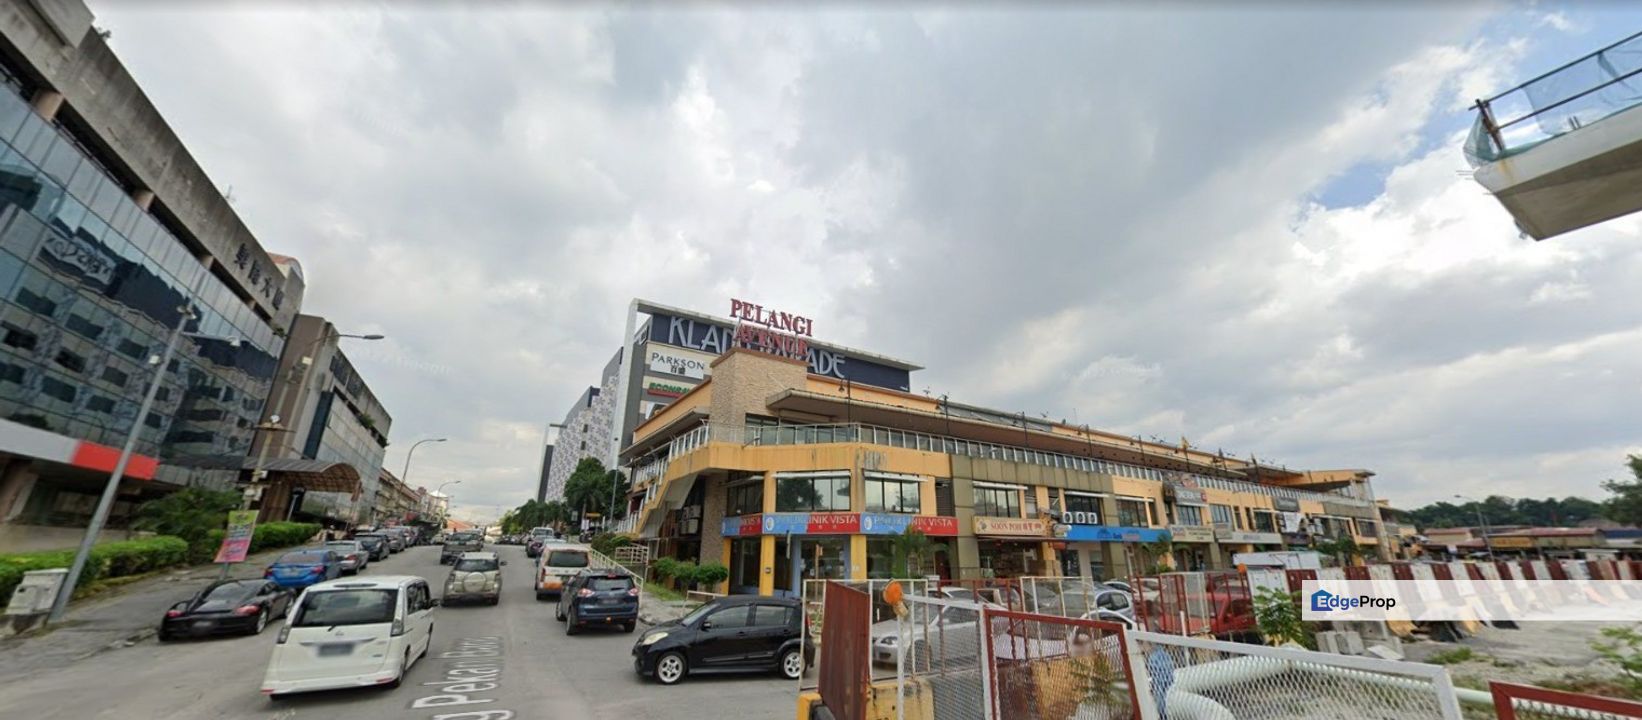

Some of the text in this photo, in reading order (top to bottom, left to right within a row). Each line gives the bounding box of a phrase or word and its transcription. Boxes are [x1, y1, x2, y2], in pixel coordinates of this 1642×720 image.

[730, 298, 813, 337] PELANGI
[652, 352, 704, 370] PARKSON
[830, 515, 858, 524] VISTA
[929, 518, 953, 527] VISTA
